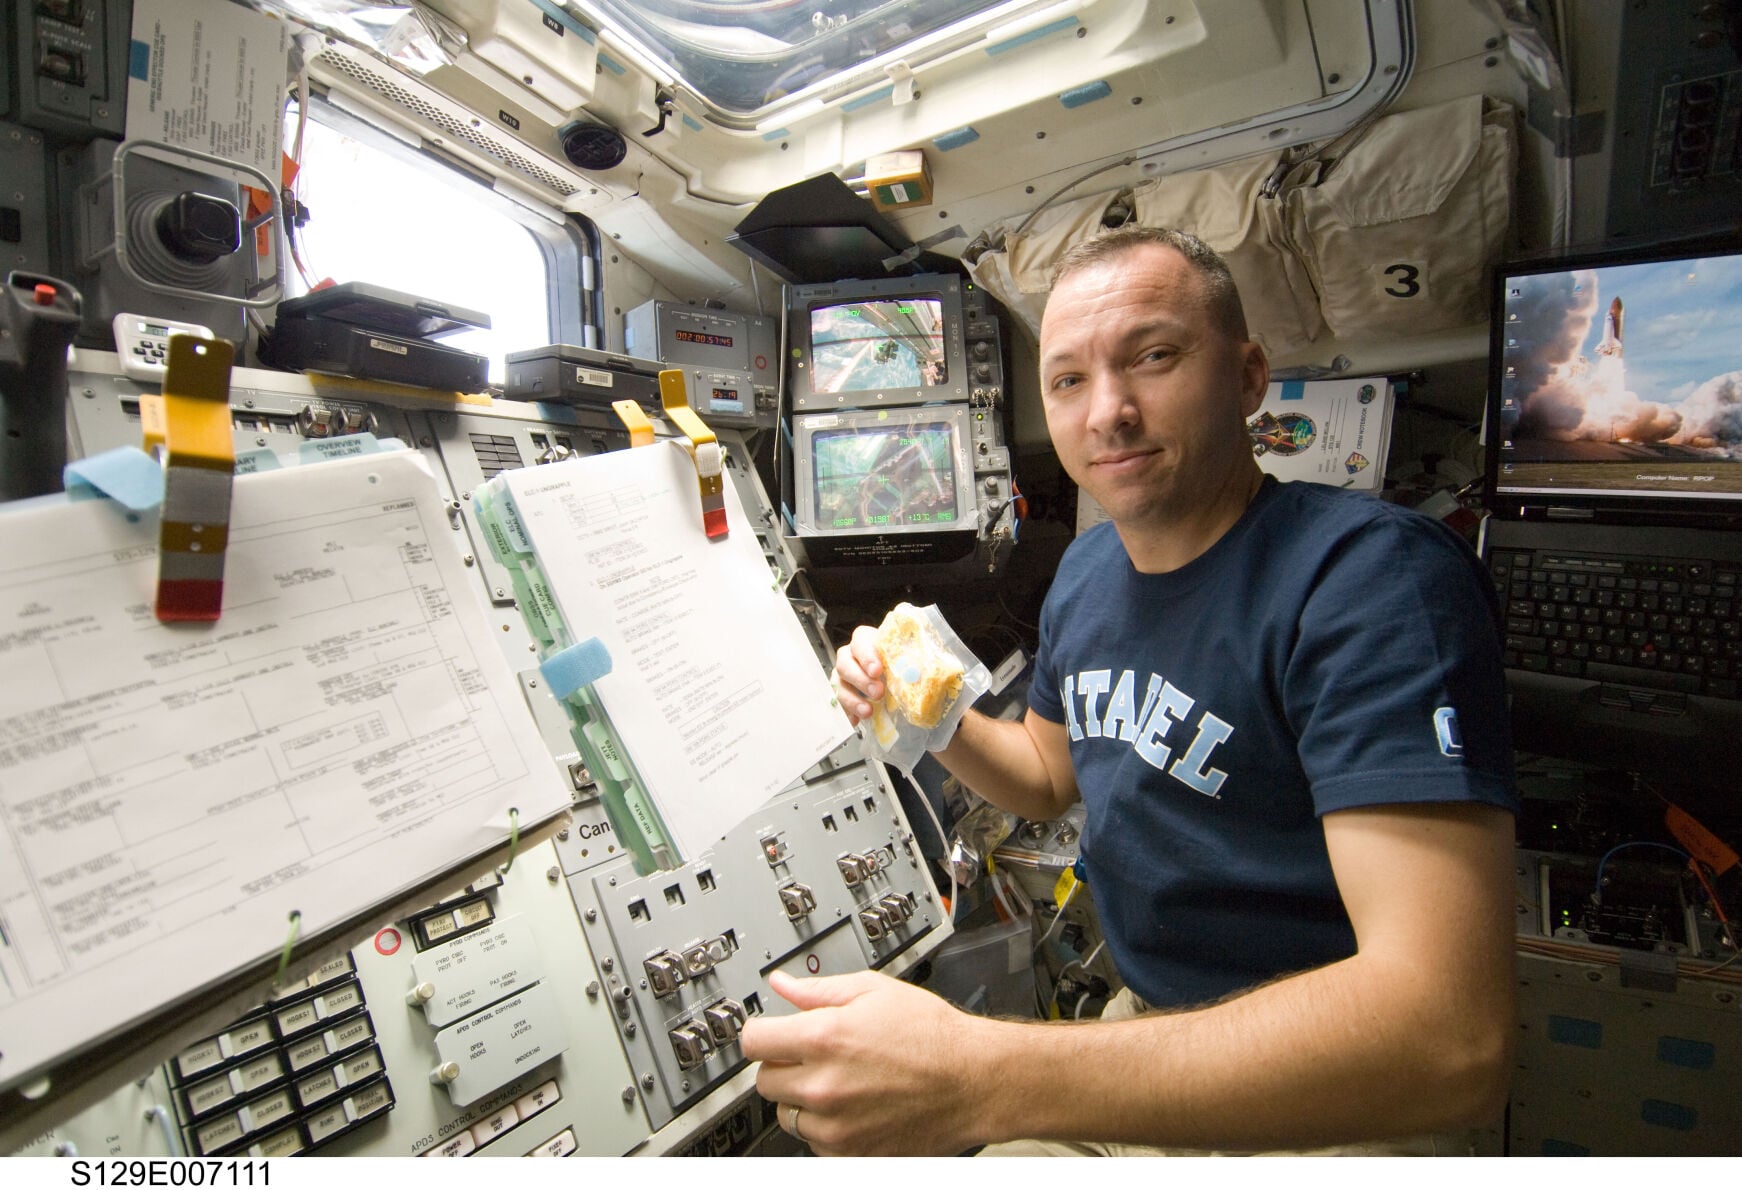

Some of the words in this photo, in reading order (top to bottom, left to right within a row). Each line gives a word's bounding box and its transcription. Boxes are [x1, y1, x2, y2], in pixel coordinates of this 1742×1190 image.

[1384, 264, 1420, 299] 3
[1358, 407, 1367, 435] NOTEBOOK
[316, 438, 362, 451] OVERVIEW
[323, 447, 362, 459] TIMELINE
[510, 516, 528, 547] NOMINAL
[1060, 668, 1235, 798] ITAEL
[604, 739, 618, 761] NOTES
[579, 821, 613, 840] Can
[320, 960, 344, 974] SEALED
[435, 955, 450, 966] PYRO
[501, 970, 518, 981] HOOKS
[499, 978, 516, 989] FIRING
[329, 993, 353, 1007] CLOSED
[458, 989, 476, 1000] HOOKS
[455, 999, 472, 1010] FIRING
[456, 1023, 470, 1035] APDS
[472, 1013, 494, 1027] CONTROL
[495, 999, 522, 1016] COMMANDS
[513, 1018, 527, 1029] OPEN
[240, 1031, 259, 1044] OPEN
[339, 1025, 363, 1040] CLOSED
[510, 1024, 532, 1039] LATCHES
[470, 1041, 484, 1052] OPEN
[469, 1048, 487, 1061] HOOKS
[514, 1046, 541, 1064] UNDOCKING
[250, 1066, 269, 1079] OPEN
[353, 1060, 369, 1073] OPEN
[303, 1077, 332, 1095] LATCHES
[256, 1101, 283, 1118] CLOSED
[411, 1134, 435, 1152] APDS
[438, 1111, 476, 1137] CONTROL
[480, 1084, 523, 1113] COMMANDS
[203, 1123, 236, 1142] LATCHES
[442, 1140, 462, 1156] POWER
[548, 1140, 563, 1152] FIXER
